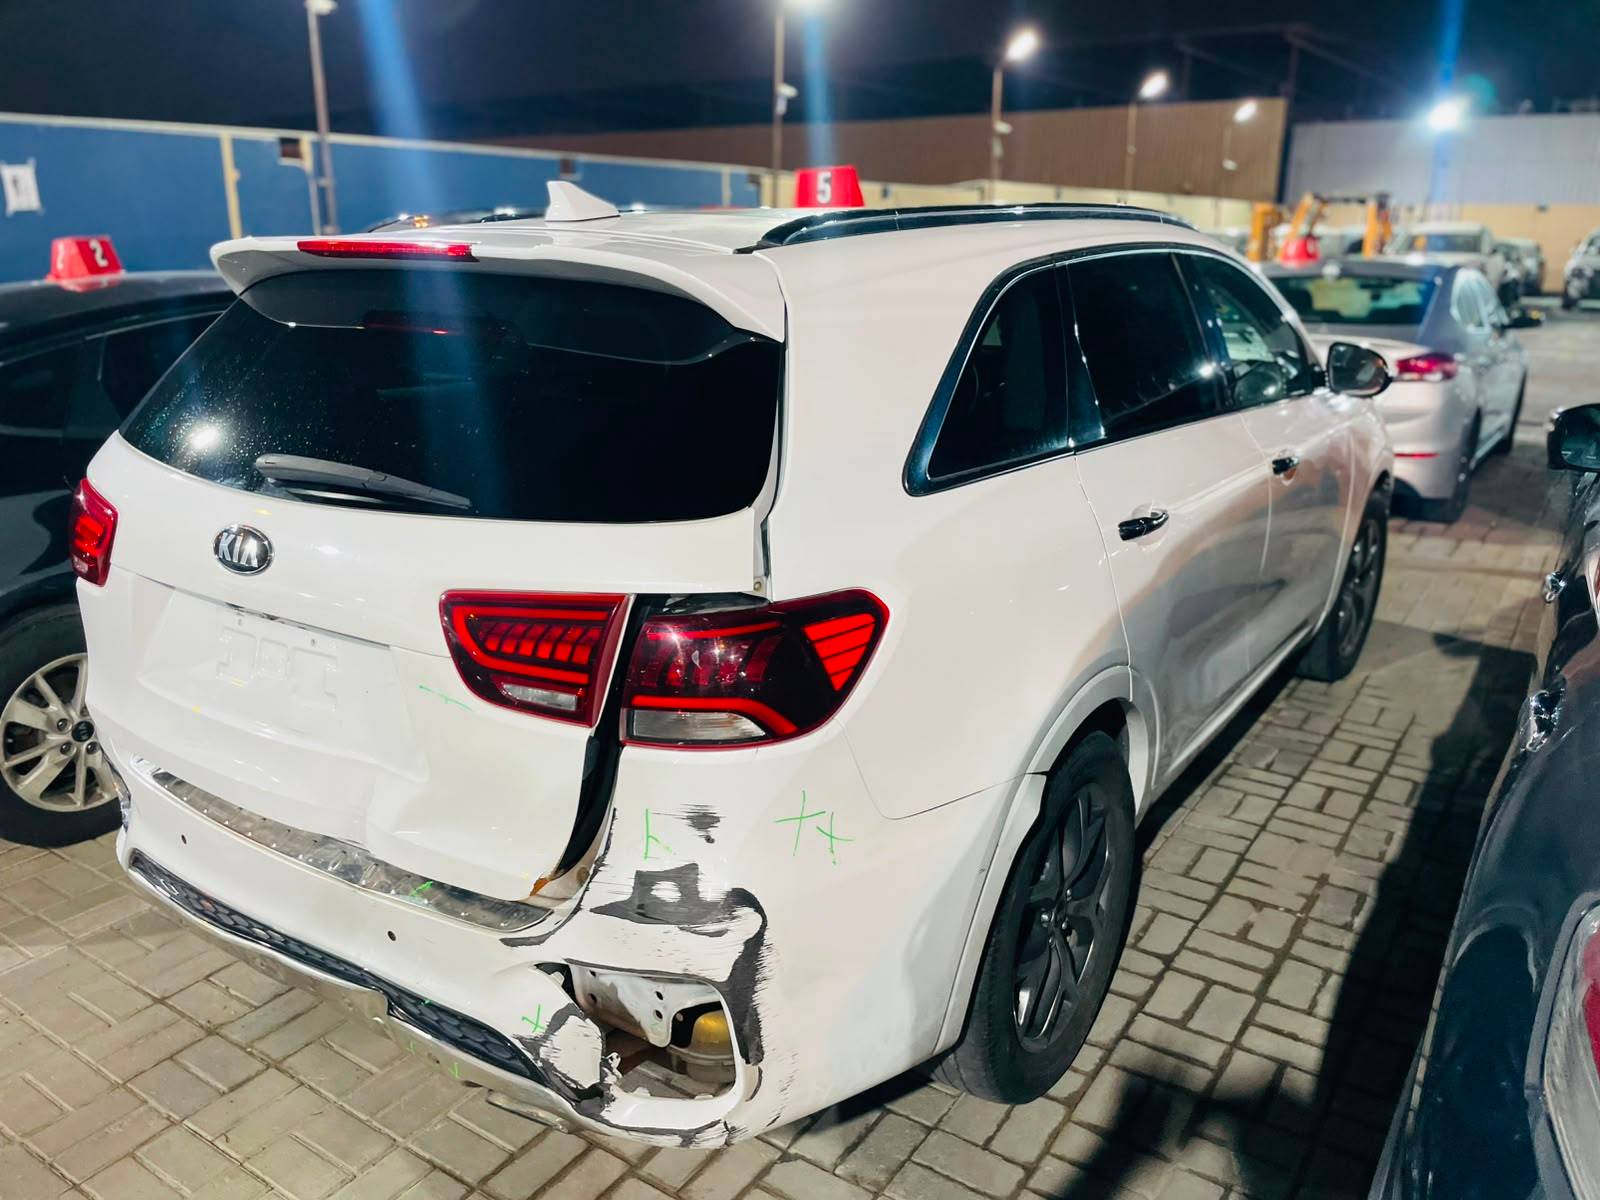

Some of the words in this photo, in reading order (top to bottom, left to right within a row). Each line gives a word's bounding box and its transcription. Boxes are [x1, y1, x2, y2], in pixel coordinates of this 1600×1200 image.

[816, 170, 832, 204] 5
[89, 239, 109, 268] 2
[218, 531, 258, 568] KIA
